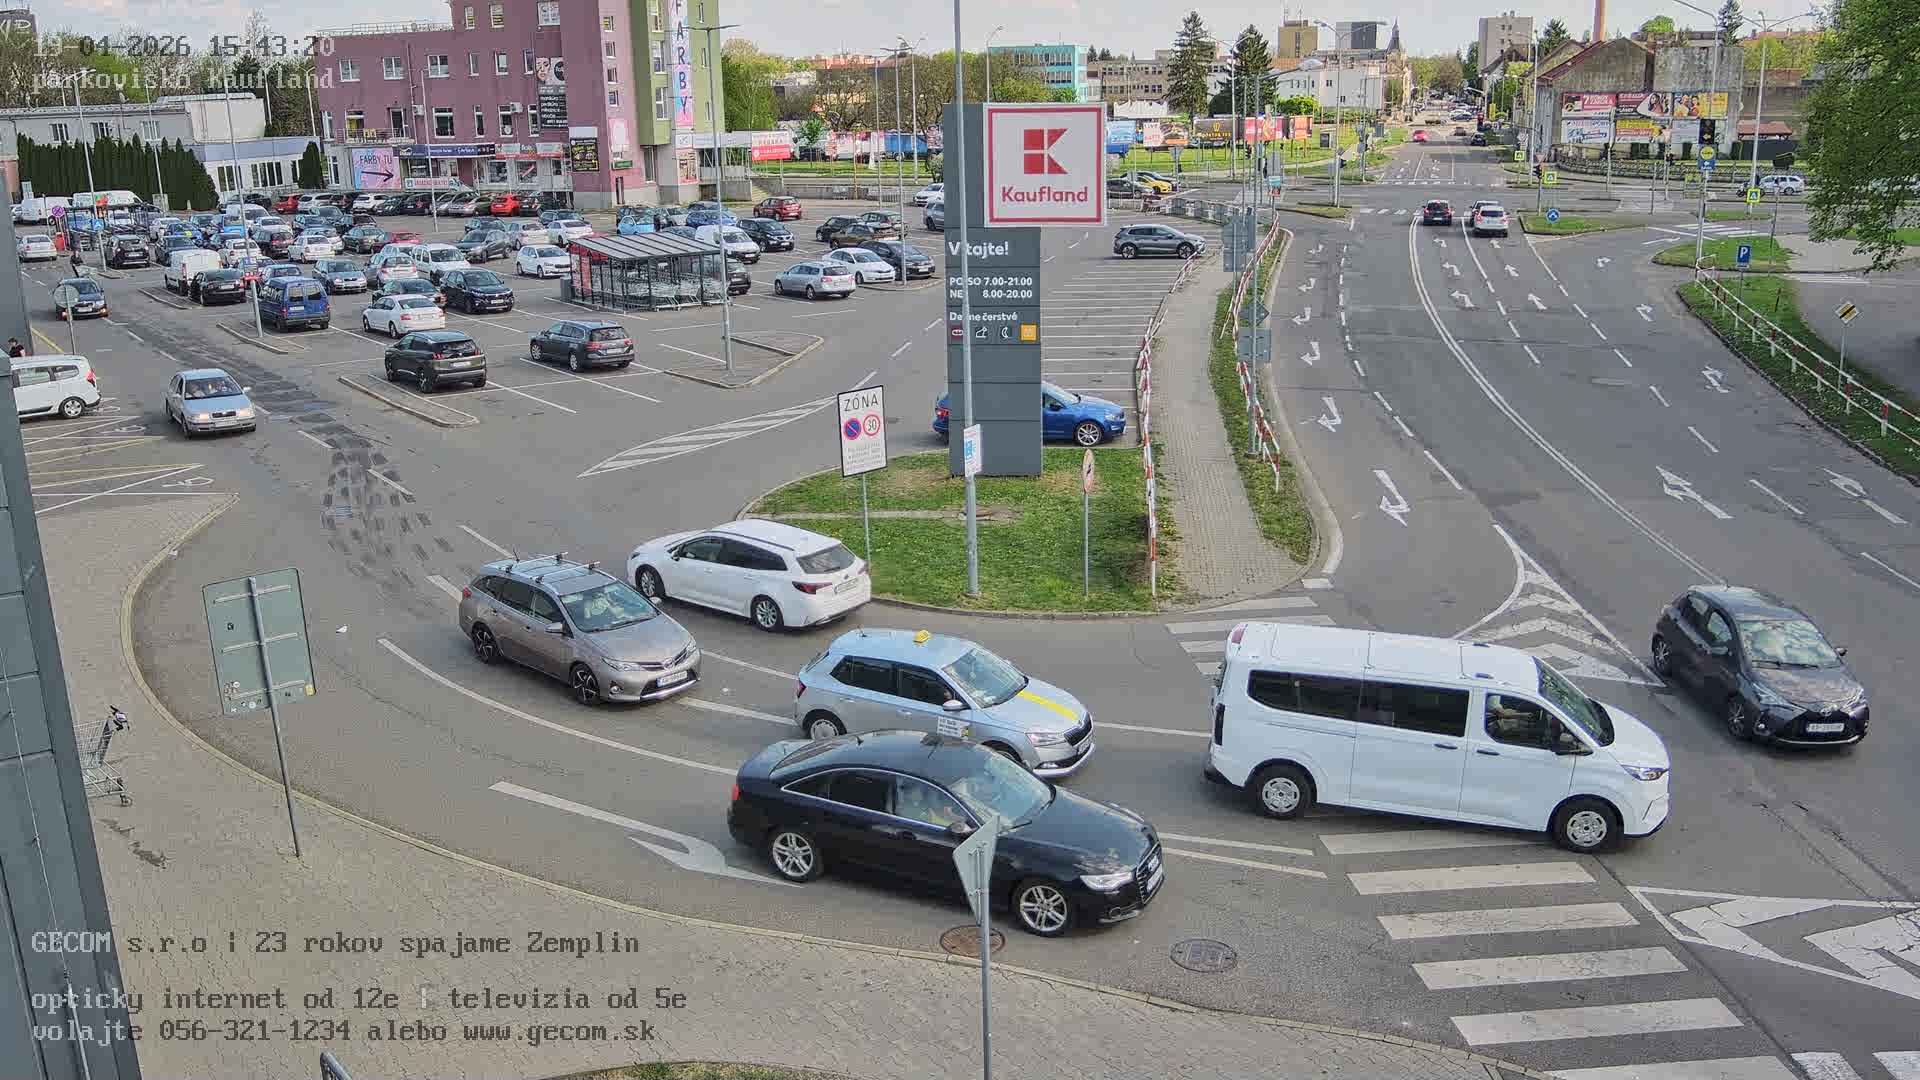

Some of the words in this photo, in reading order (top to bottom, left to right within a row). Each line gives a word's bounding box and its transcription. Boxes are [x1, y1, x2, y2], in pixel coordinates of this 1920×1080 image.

[360, 155, 380, 164] FARBY
[384, 155, 392, 164] TU
[1001, 186, 1088, 202] Kaufland
[948, 241, 1009, 259] Vtajte!
[1740, 246, 1748, 258] P
[949, 277, 981, 286] POSO
[983, 277, 1033, 286] 7.00-21.00
[949, 289, 964, 298] NE
[982, 289, 1033, 298] 8.00-20.00
[949, 311, 980, 321] Dene
[982, 311, 1018, 321] čerstvé
[844, 393, 879, 411] ZÓNA
[867, 419, 877, 431] 30
